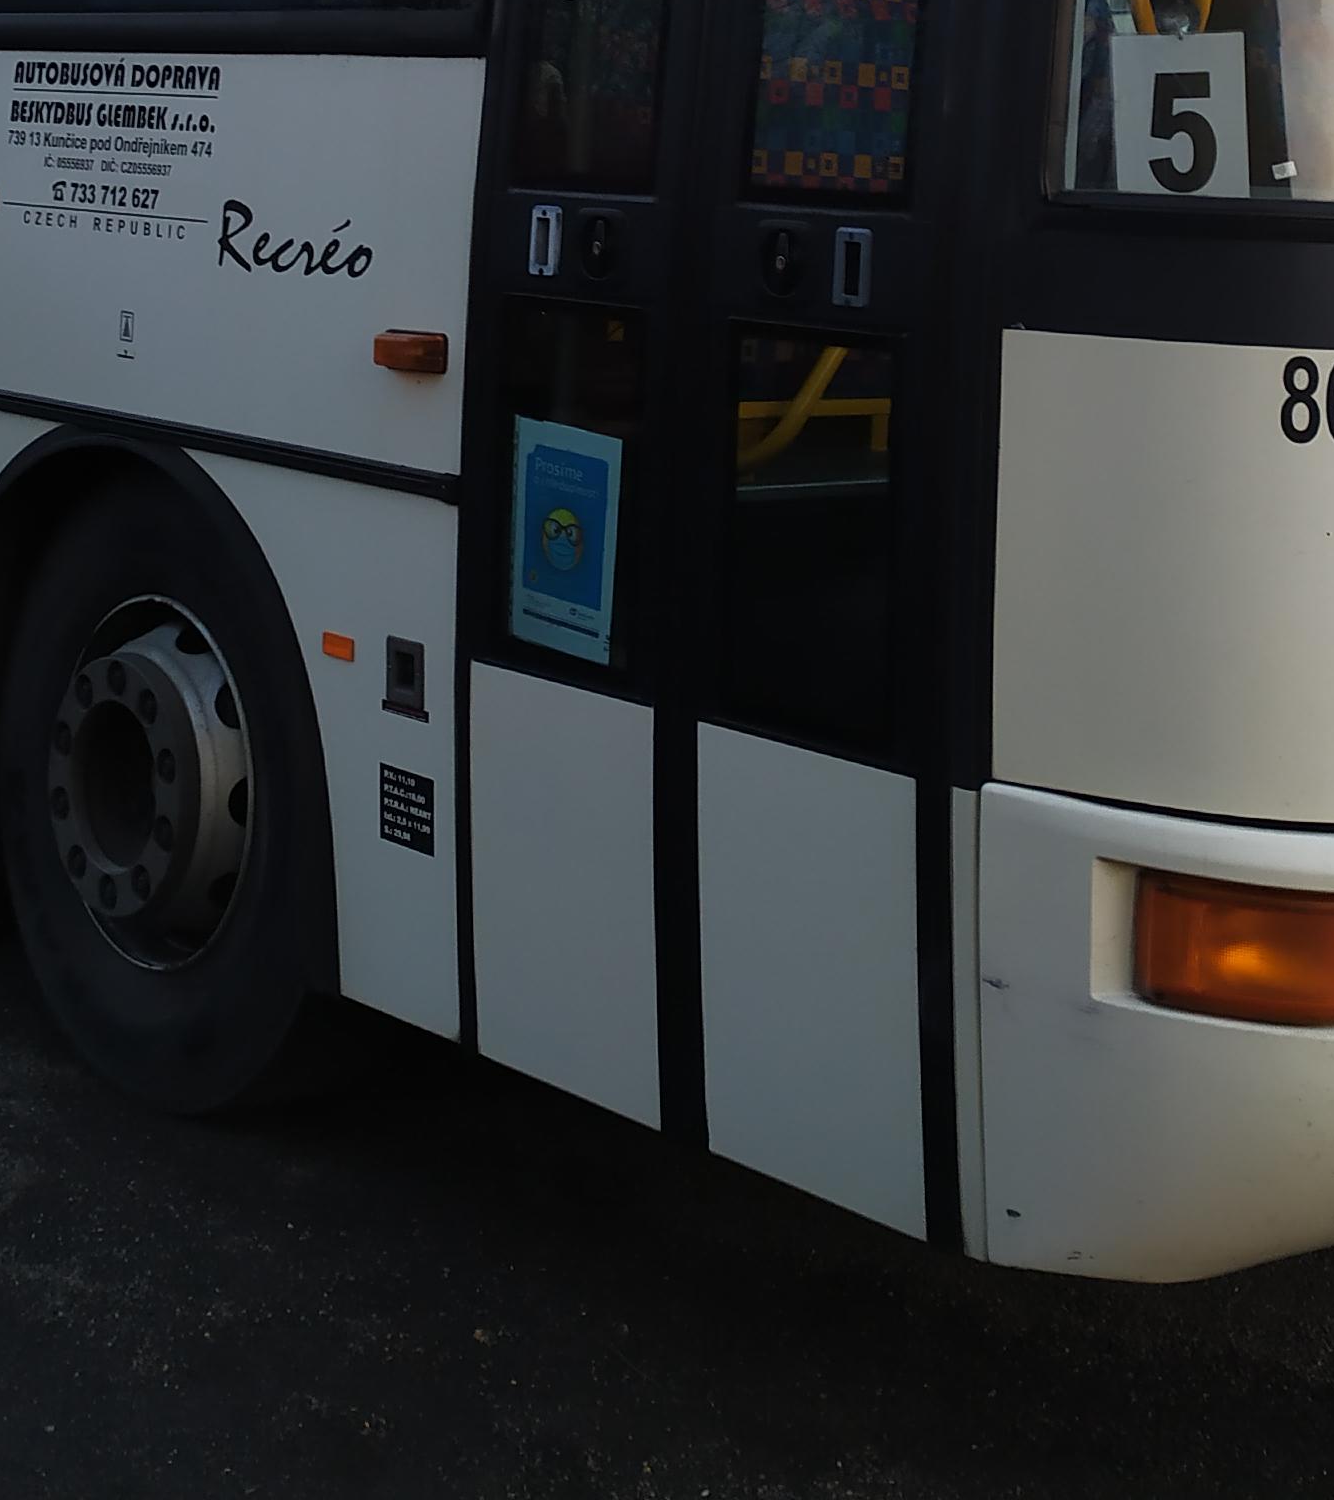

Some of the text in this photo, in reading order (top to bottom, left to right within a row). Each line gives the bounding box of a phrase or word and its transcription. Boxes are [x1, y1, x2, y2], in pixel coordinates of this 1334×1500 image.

[14, 57, 221, 90] AUTOBUSOVÁ DOPRAVA
[10, 100, 216, 133] BESKYDBUS GLEMBEK s.r.o.
[1149, 71, 1218, 194] 5
[8, 129, 26, 146] 739
[29, 131, 41, 147] 13
[43, 132, 87, 150] Kunčice
[89, 135, 112, 154] pod
[191, 141, 212, 158] 474
[70, 182, 160, 210] 733 712 627
[23, 210, 186, 240] CZECH REPUBLIC
[218, 200, 373, 278] Recréo
